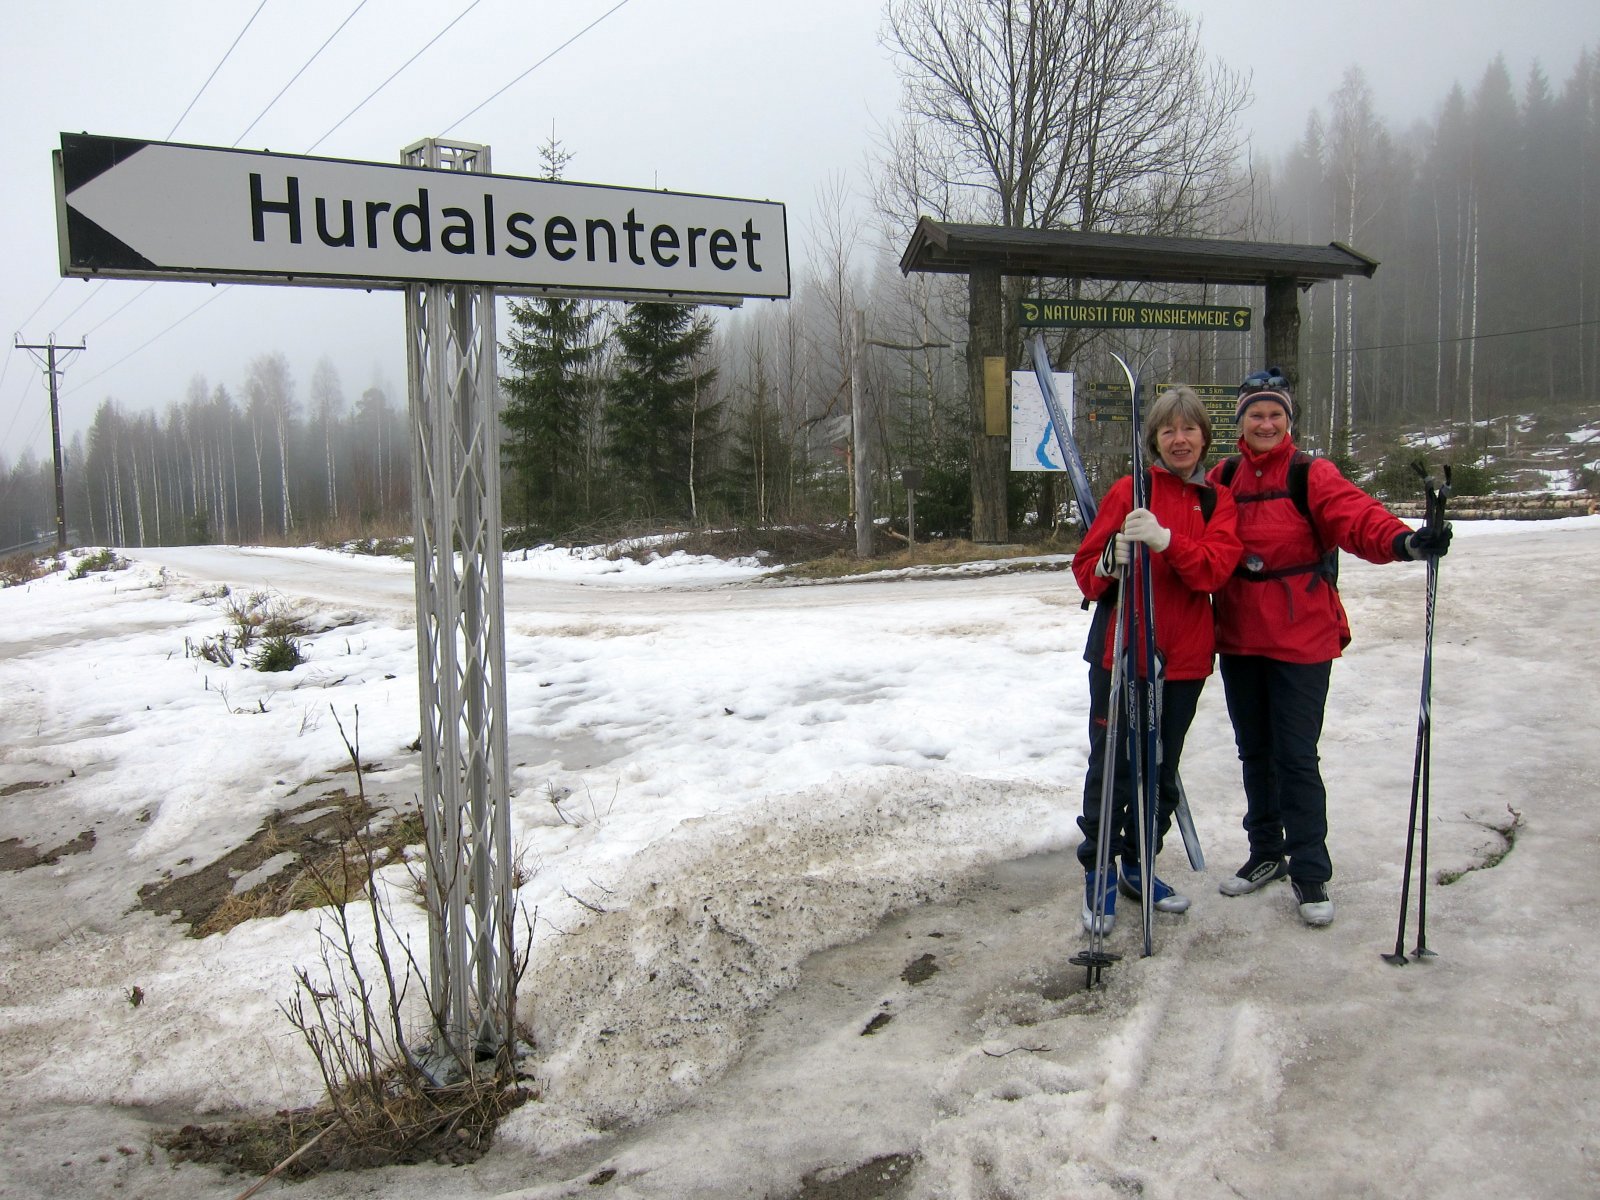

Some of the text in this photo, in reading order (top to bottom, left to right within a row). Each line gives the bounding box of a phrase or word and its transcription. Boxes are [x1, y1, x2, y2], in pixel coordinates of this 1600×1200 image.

[249, 173, 763, 273] Hurdalsenteret
[1043, 305, 1230, 326] NATURSTI FOR SYNSHEMMEDE
